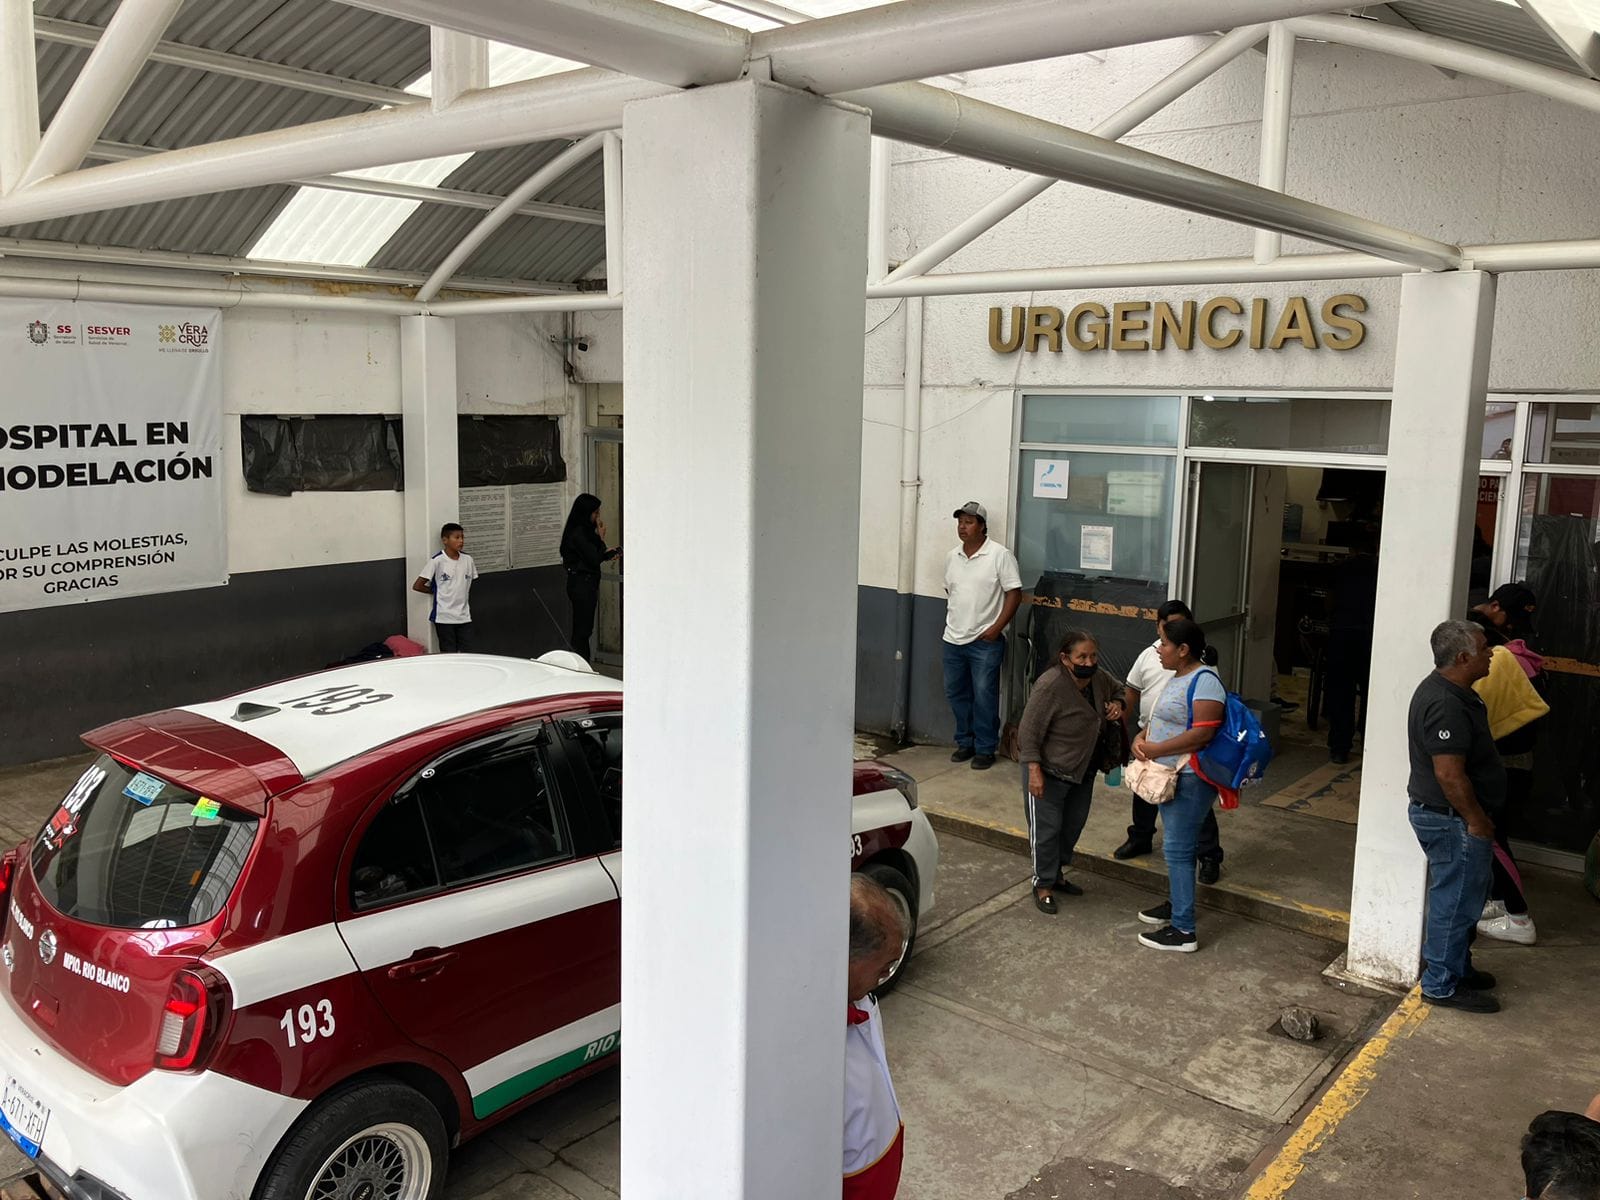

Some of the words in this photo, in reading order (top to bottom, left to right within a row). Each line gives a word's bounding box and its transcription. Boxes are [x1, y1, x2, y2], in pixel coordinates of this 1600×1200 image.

[57, 325, 72, 334] SS
[87, 326, 131, 336] SESVER
[178, 322, 208, 335] VERA
[987, 294, 1368, 353] URGENCIAS
[178, 334, 208, 347] CRUZ
[0, 423, 137, 450] SPITAL
[146, 421, 189, 445] EN
[0, 451, 212, 491] ODELACIÓN
[56, 541, 89, 556] LAS
[93, 533, 188, 553] MOLESTIAS,
[22, 564, 46, 579] SU
[51, 550, 176, 575] COMPRENSIÓN
[43, 575, 119, 594] GRACIAS
[278, 684, 394, 716] 193
[63, 951, 81, 975] MPIO.
[82, 960, 96, 981] RIO
[96, 967, 130, 994] BLANCO
[279, 998, 336, 1048] 193
[584, 1034, 616, 1061] RIO
